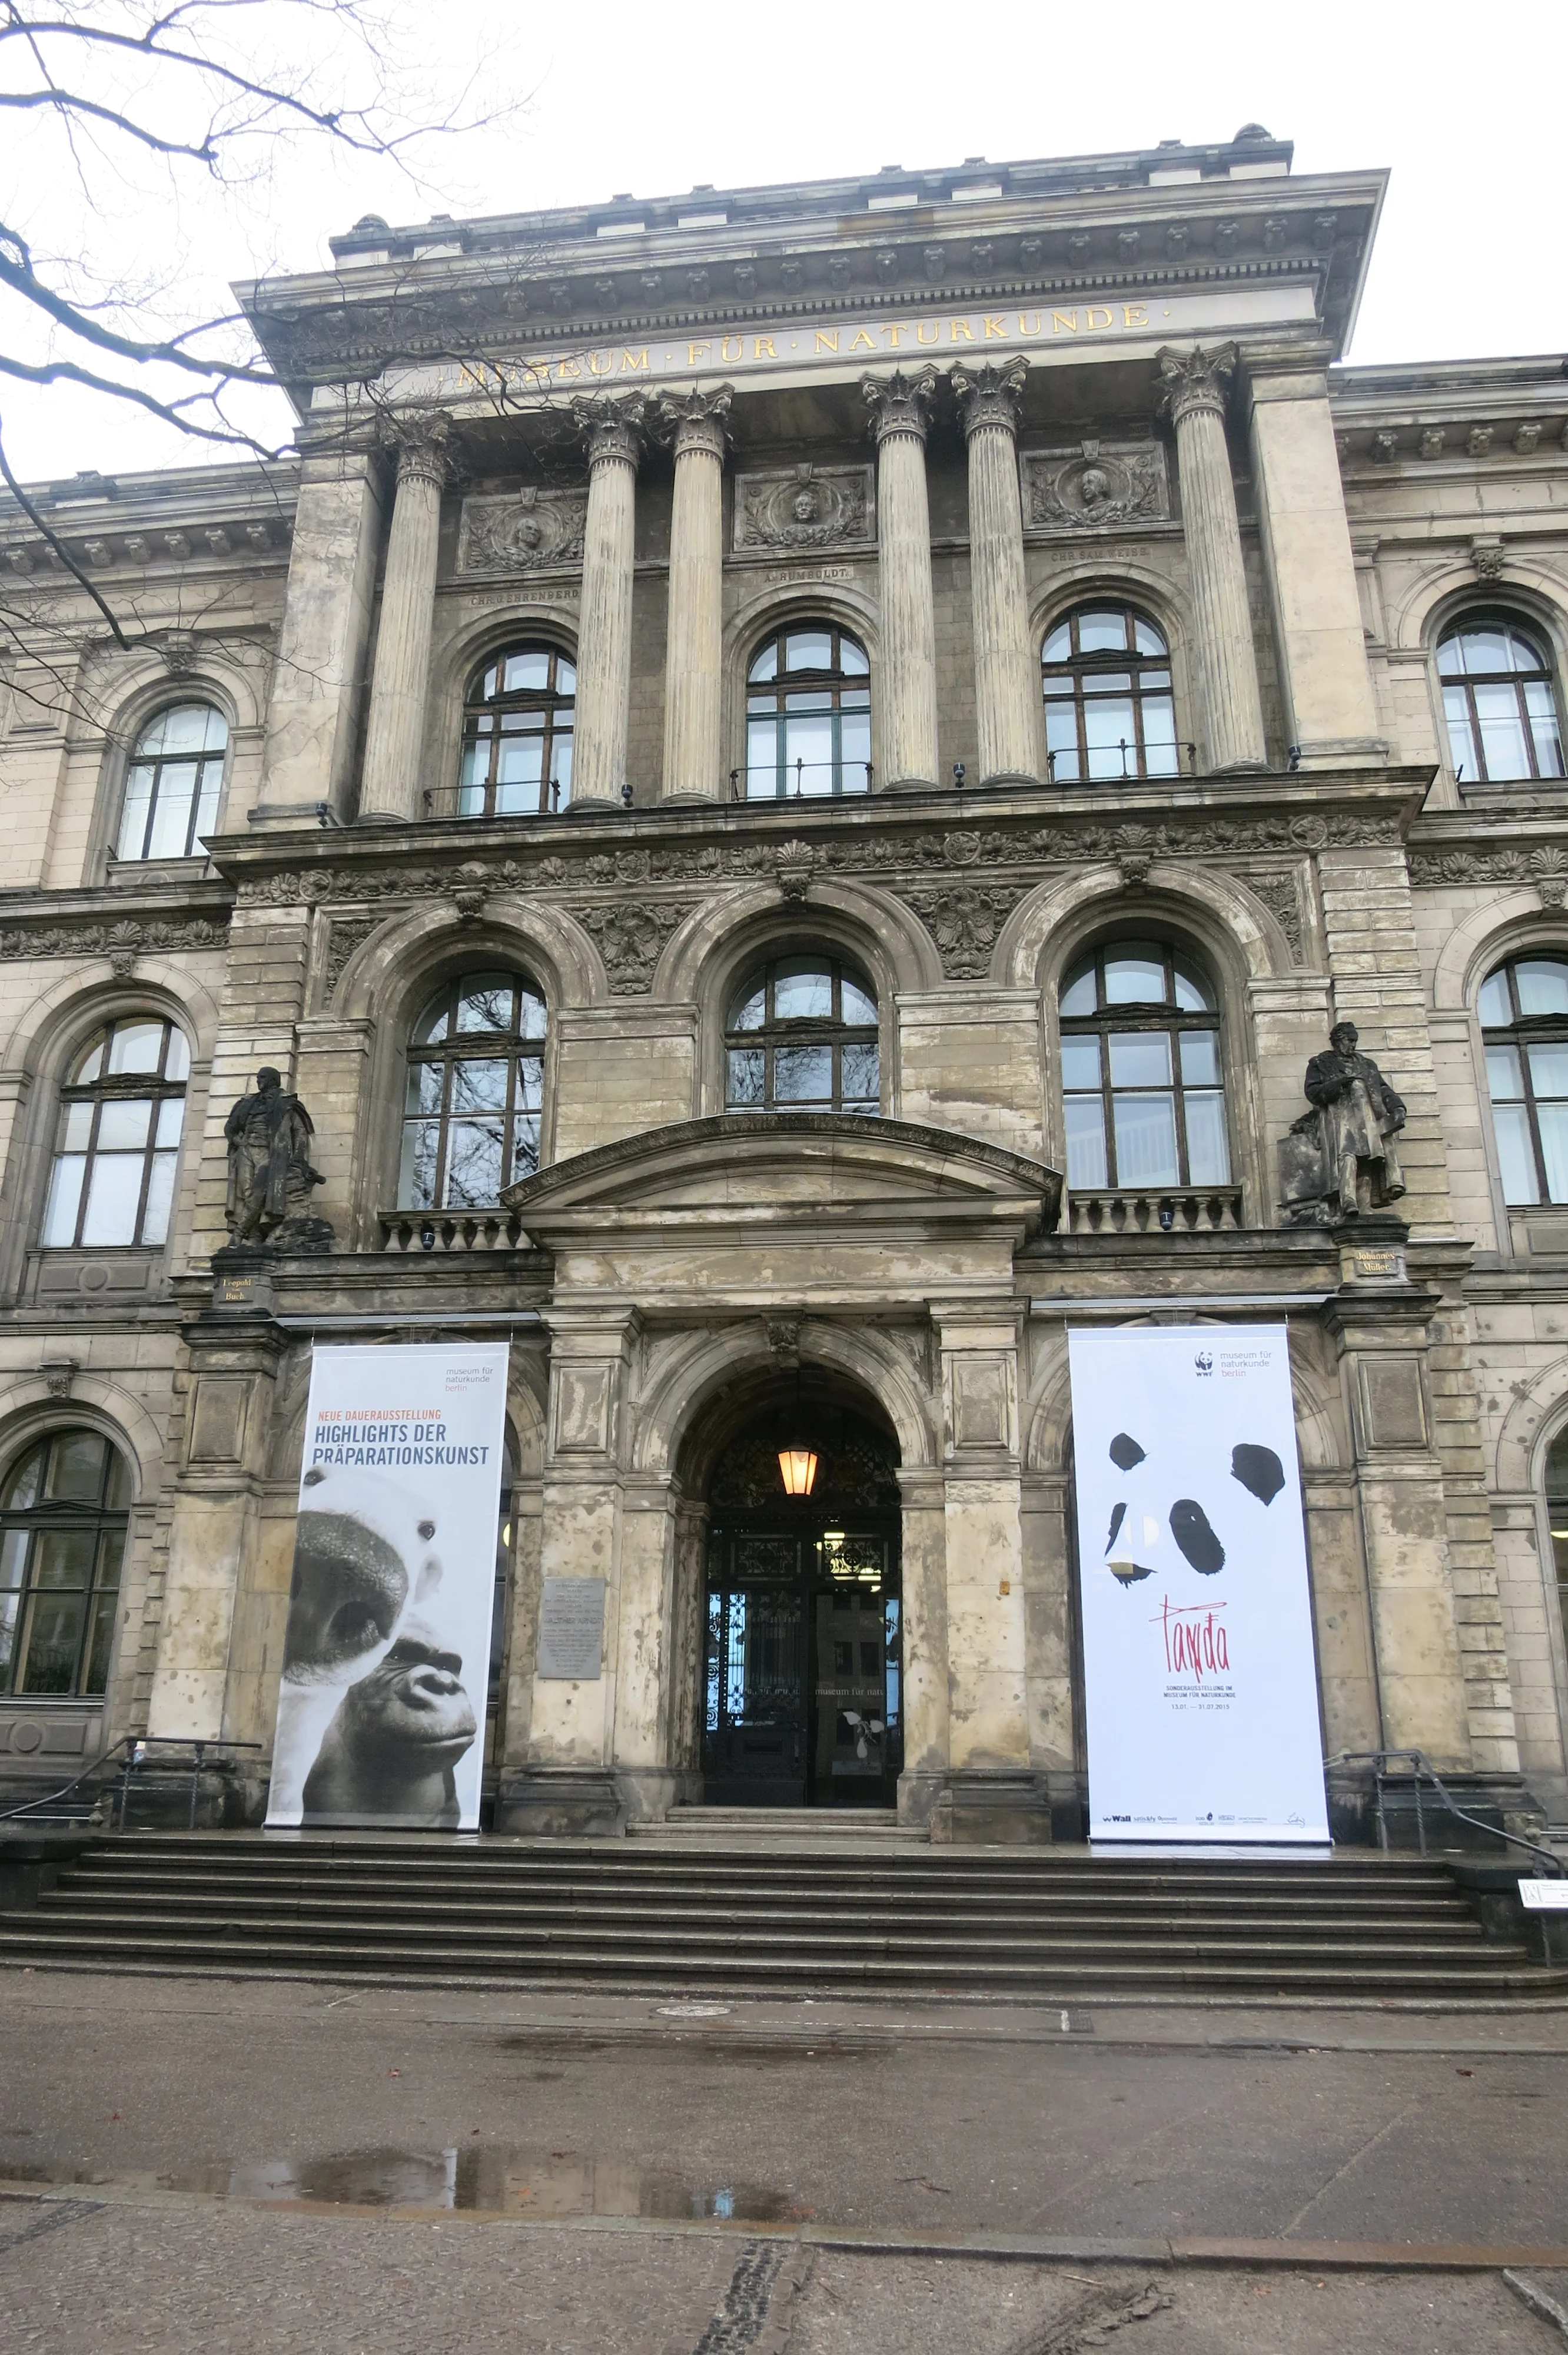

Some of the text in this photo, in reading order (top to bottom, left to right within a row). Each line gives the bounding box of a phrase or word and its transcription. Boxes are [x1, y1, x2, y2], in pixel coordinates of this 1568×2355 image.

[456, 306, 1150, 389] MUSEUM FÜR NATURKUNDE
[1356, 1252, 1396, 1261] Johannes
[223, 1279, 251, 1288] Leopold
[1220, 1350, 1272, 1359] museum für
[1221, 1359, 1270, 1368] naturkunde
[446, 1366, 494, 1375] museum für
[1221, 1368, 1247, 1377] berlin
[446, 1375, 490, 1384] naturkunde
[445, 1384, 467, 1392] berlin
[318, 1409, 441, 1421] NEUE DAUERAUSSTELLUNG
[315, 1424, 447, 1444] HIGHLIGHTS DER
[313, 1444, 490, 1466] PRÄPARATIONSKUNST
[851, 1686, 865, 1696] für
